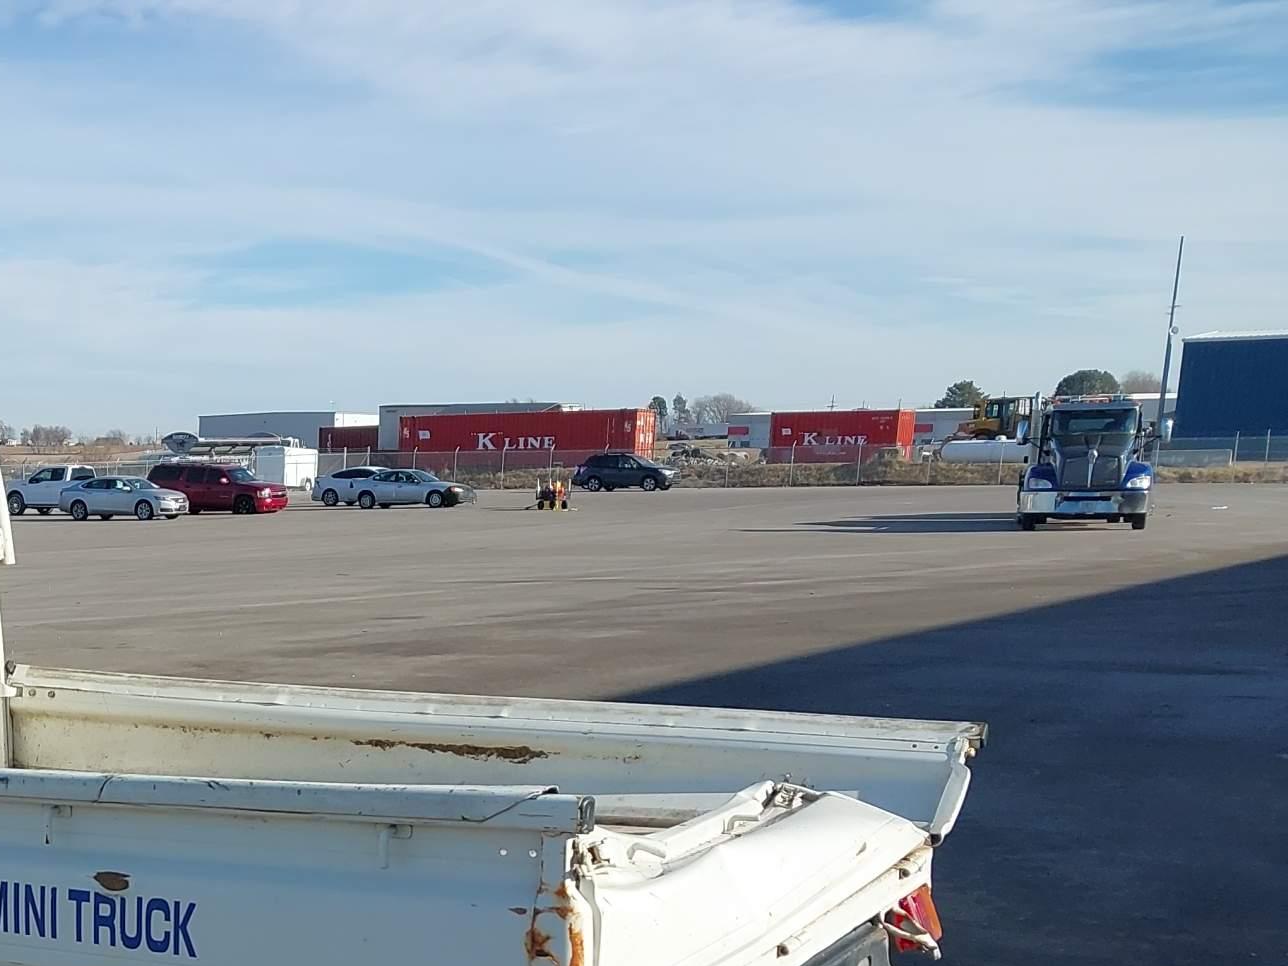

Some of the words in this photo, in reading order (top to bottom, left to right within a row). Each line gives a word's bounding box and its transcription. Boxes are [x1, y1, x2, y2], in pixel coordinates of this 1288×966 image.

[504, 437, 555, 450] LINE
[825, 435, 868, 446] LINE
[67, 888, 198, 958] TRUCK
